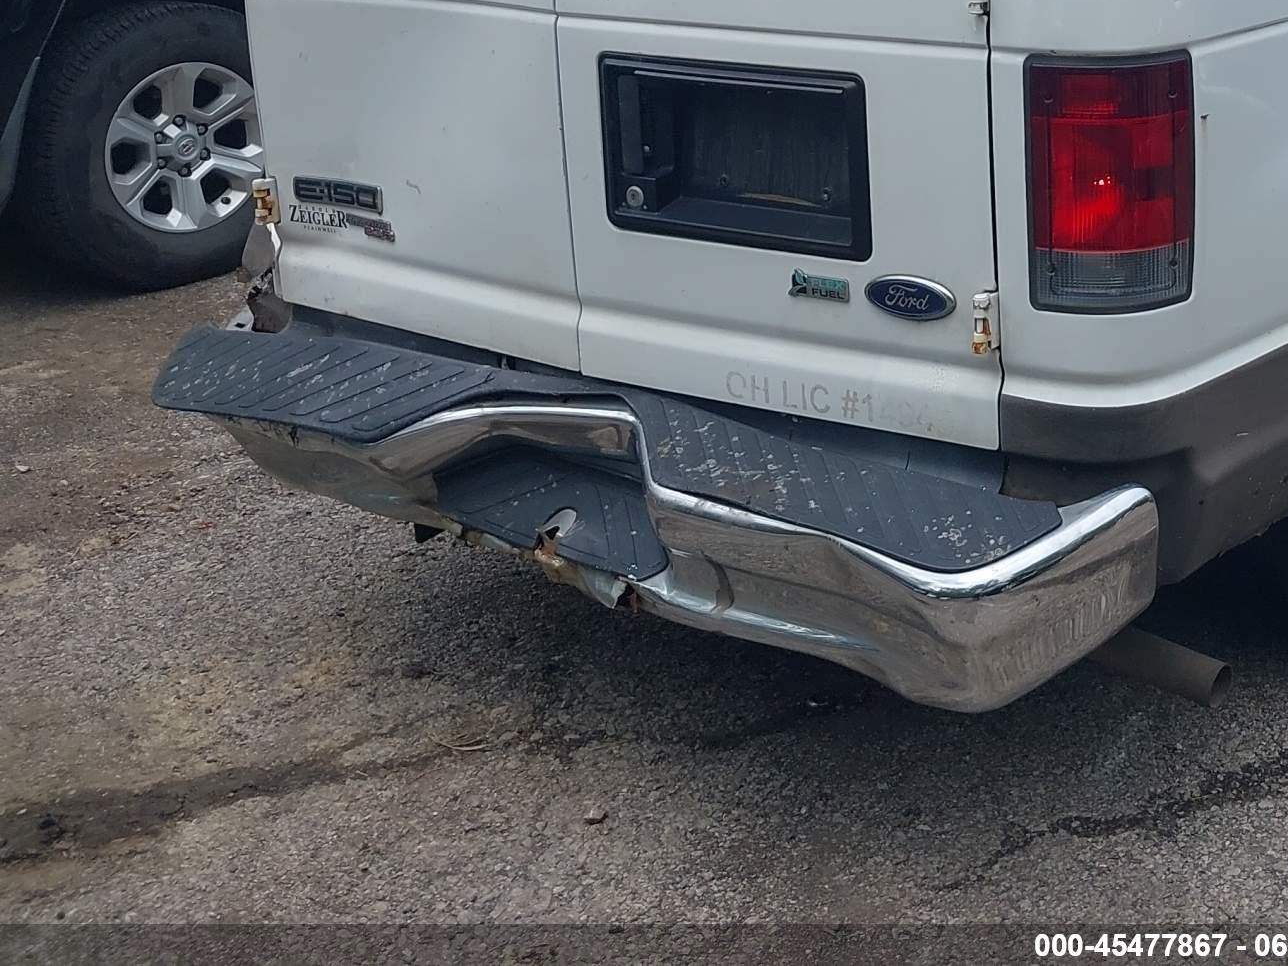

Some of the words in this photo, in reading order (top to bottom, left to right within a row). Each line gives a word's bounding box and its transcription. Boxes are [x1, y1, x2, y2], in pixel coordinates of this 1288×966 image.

[288, 204, 348, 229] ZEIGLER
[811, 287, 846, 300] FUEL
[884, 284, 930, 311] Ford
[782, 380, 831, 414] LIC
